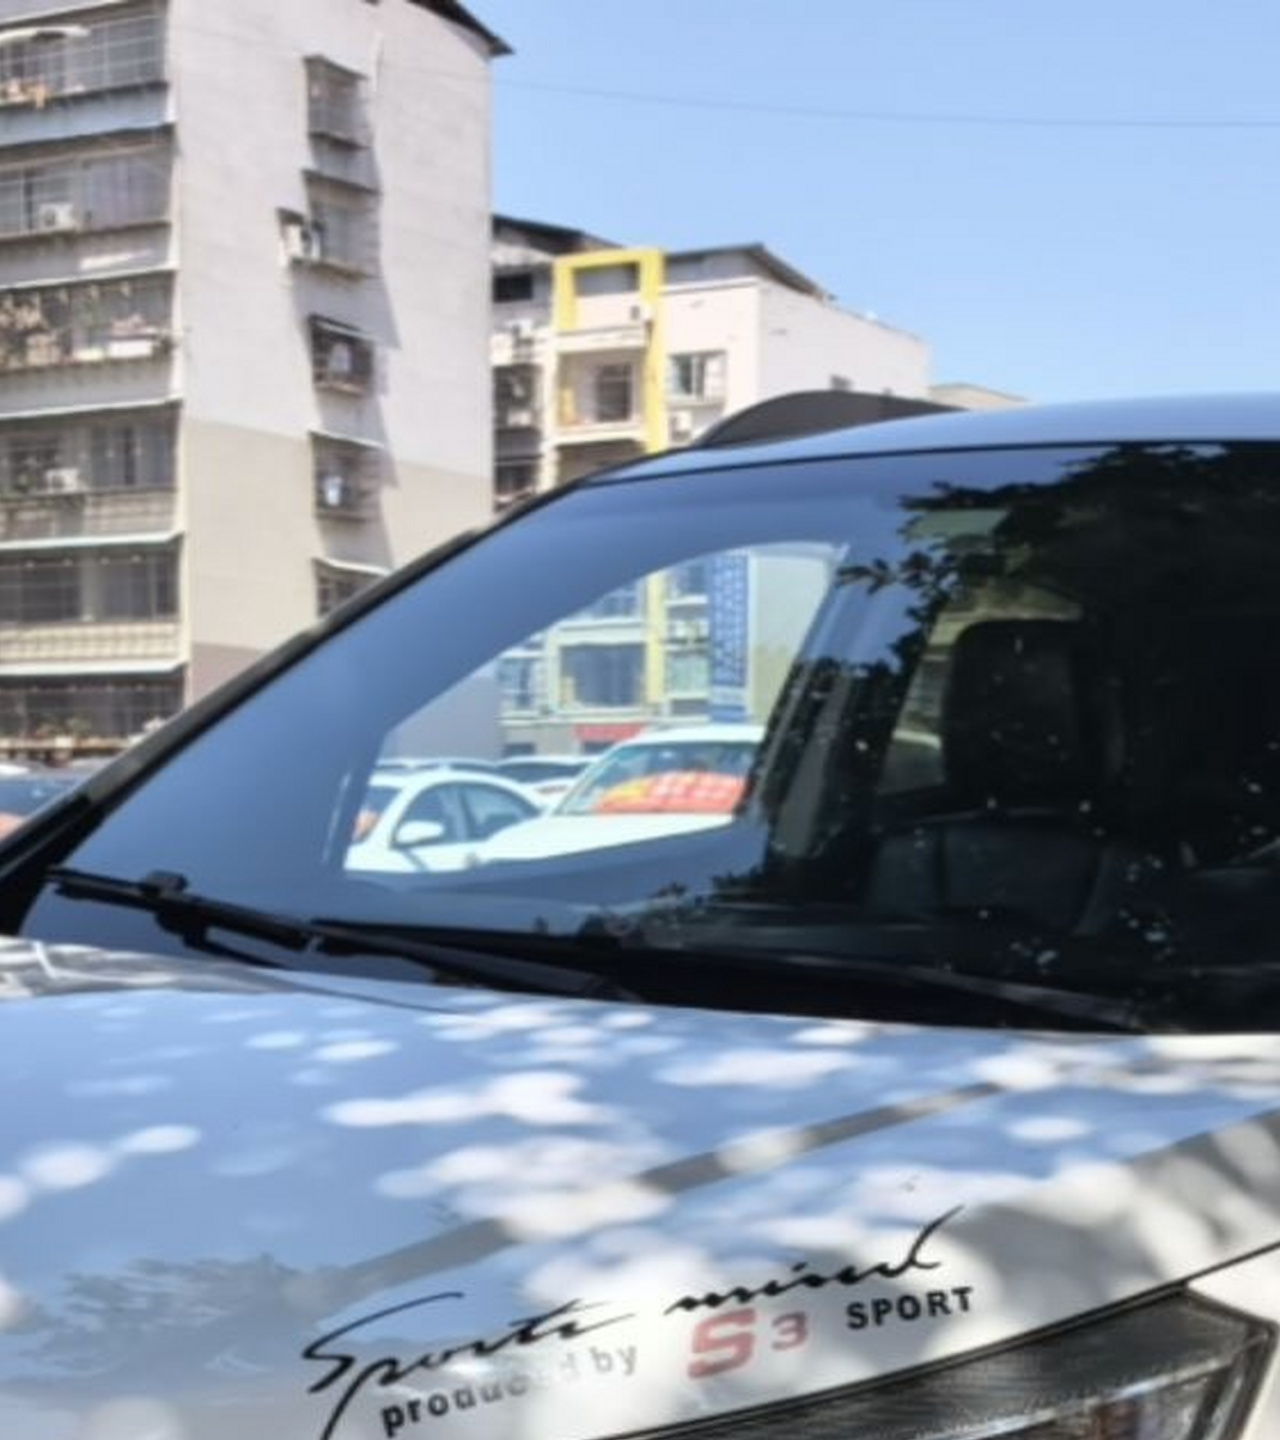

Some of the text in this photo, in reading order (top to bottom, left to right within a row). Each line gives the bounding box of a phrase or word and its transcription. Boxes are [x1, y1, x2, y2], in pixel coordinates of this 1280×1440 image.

[379, 1352, 581, 1439] producd
[589, 1345, 638, 1377] by
[845, 1286, 973, 1331] SPORT
